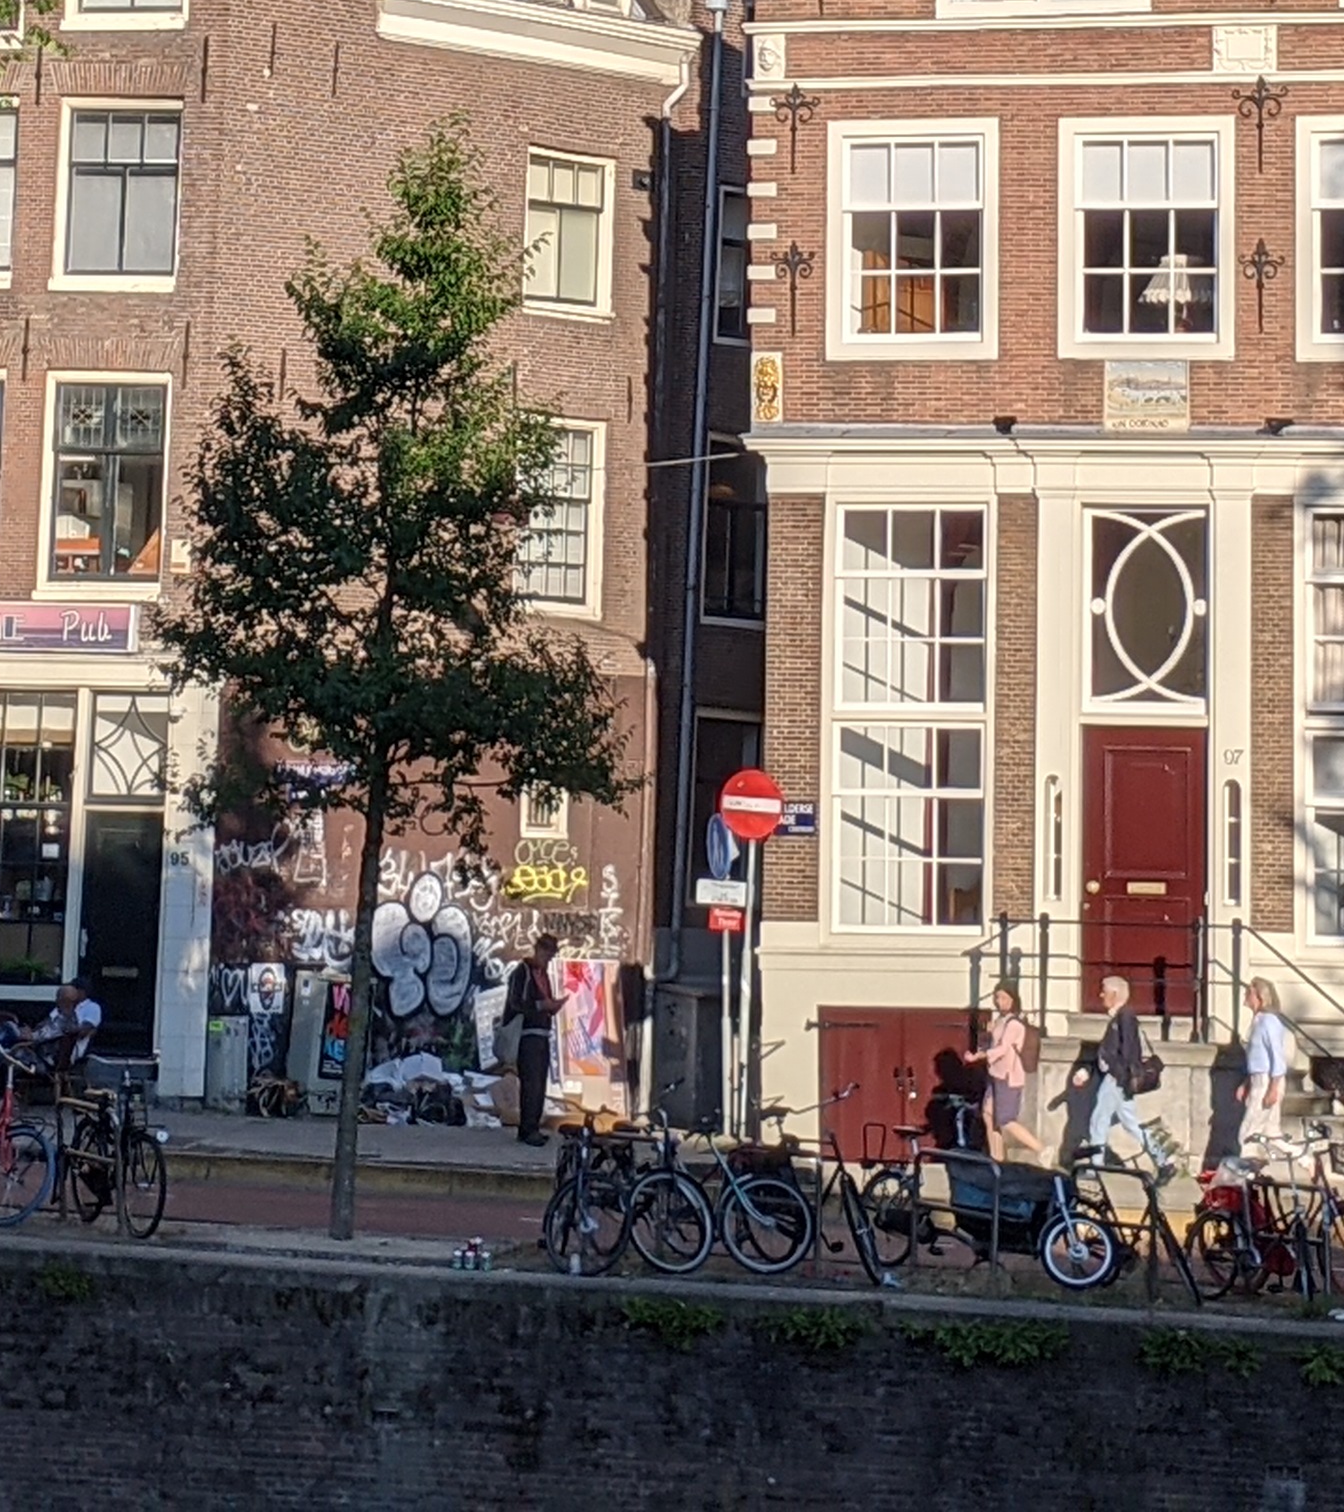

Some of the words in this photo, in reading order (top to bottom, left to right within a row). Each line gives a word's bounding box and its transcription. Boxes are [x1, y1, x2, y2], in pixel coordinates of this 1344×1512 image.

[59, 609, 112, 643] Pub
[783, 803, 814, 814] LDERSE
[777, 814, 796, 826] ADE
[169, 852, 190, 867] 95
